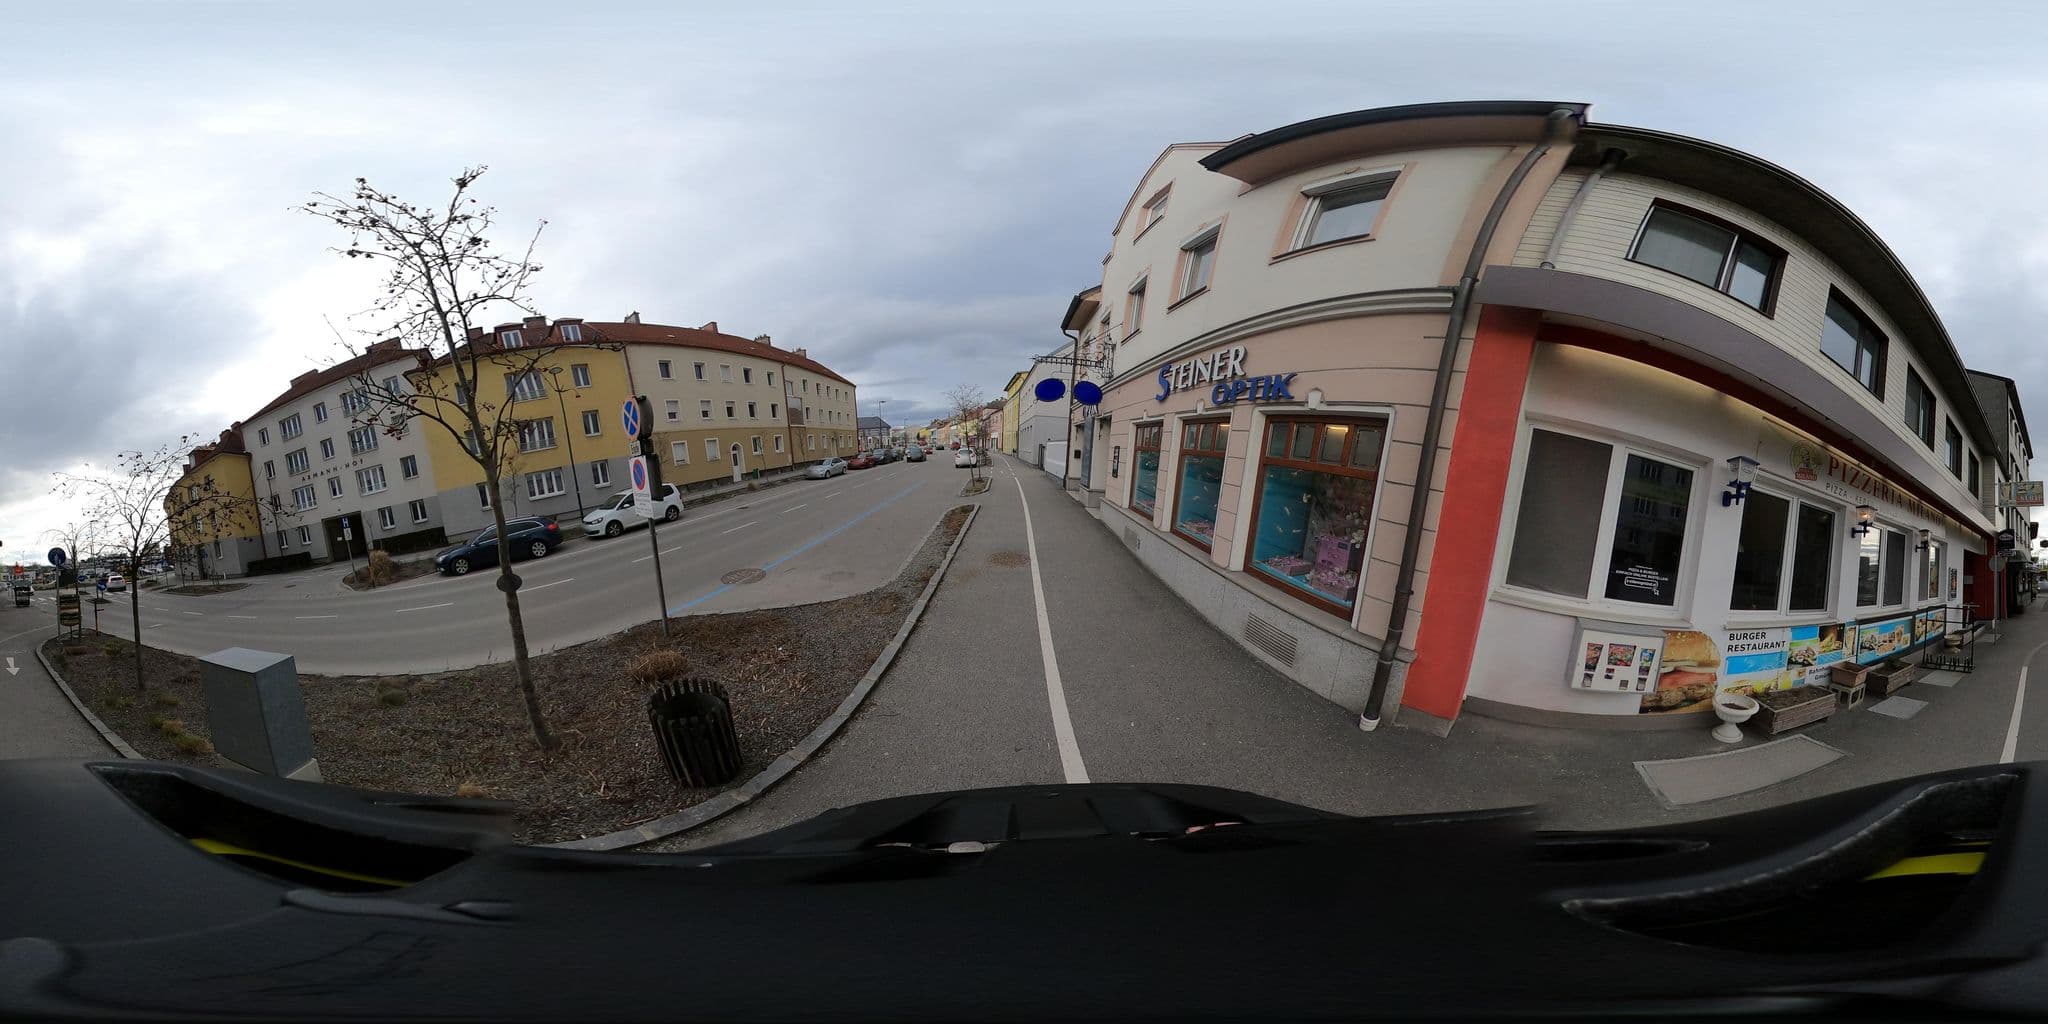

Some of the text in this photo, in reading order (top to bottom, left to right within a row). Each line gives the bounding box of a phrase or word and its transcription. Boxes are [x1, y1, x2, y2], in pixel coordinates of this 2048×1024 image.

[1155, 344, 1248, 402] STEINER
[1211, 371, 1298, 407] OPTIK
[1825, 482, 1848, 499] PIZZA
[1827, 454, 1904, 508] PIZZERIA
[342, 517, 349, 528] H
[1907, 498, 1944, 527] MILANO
[1727, 640, 1787, 653] RESTAURANT
[1728, 631, 1767, 641] BURGER
